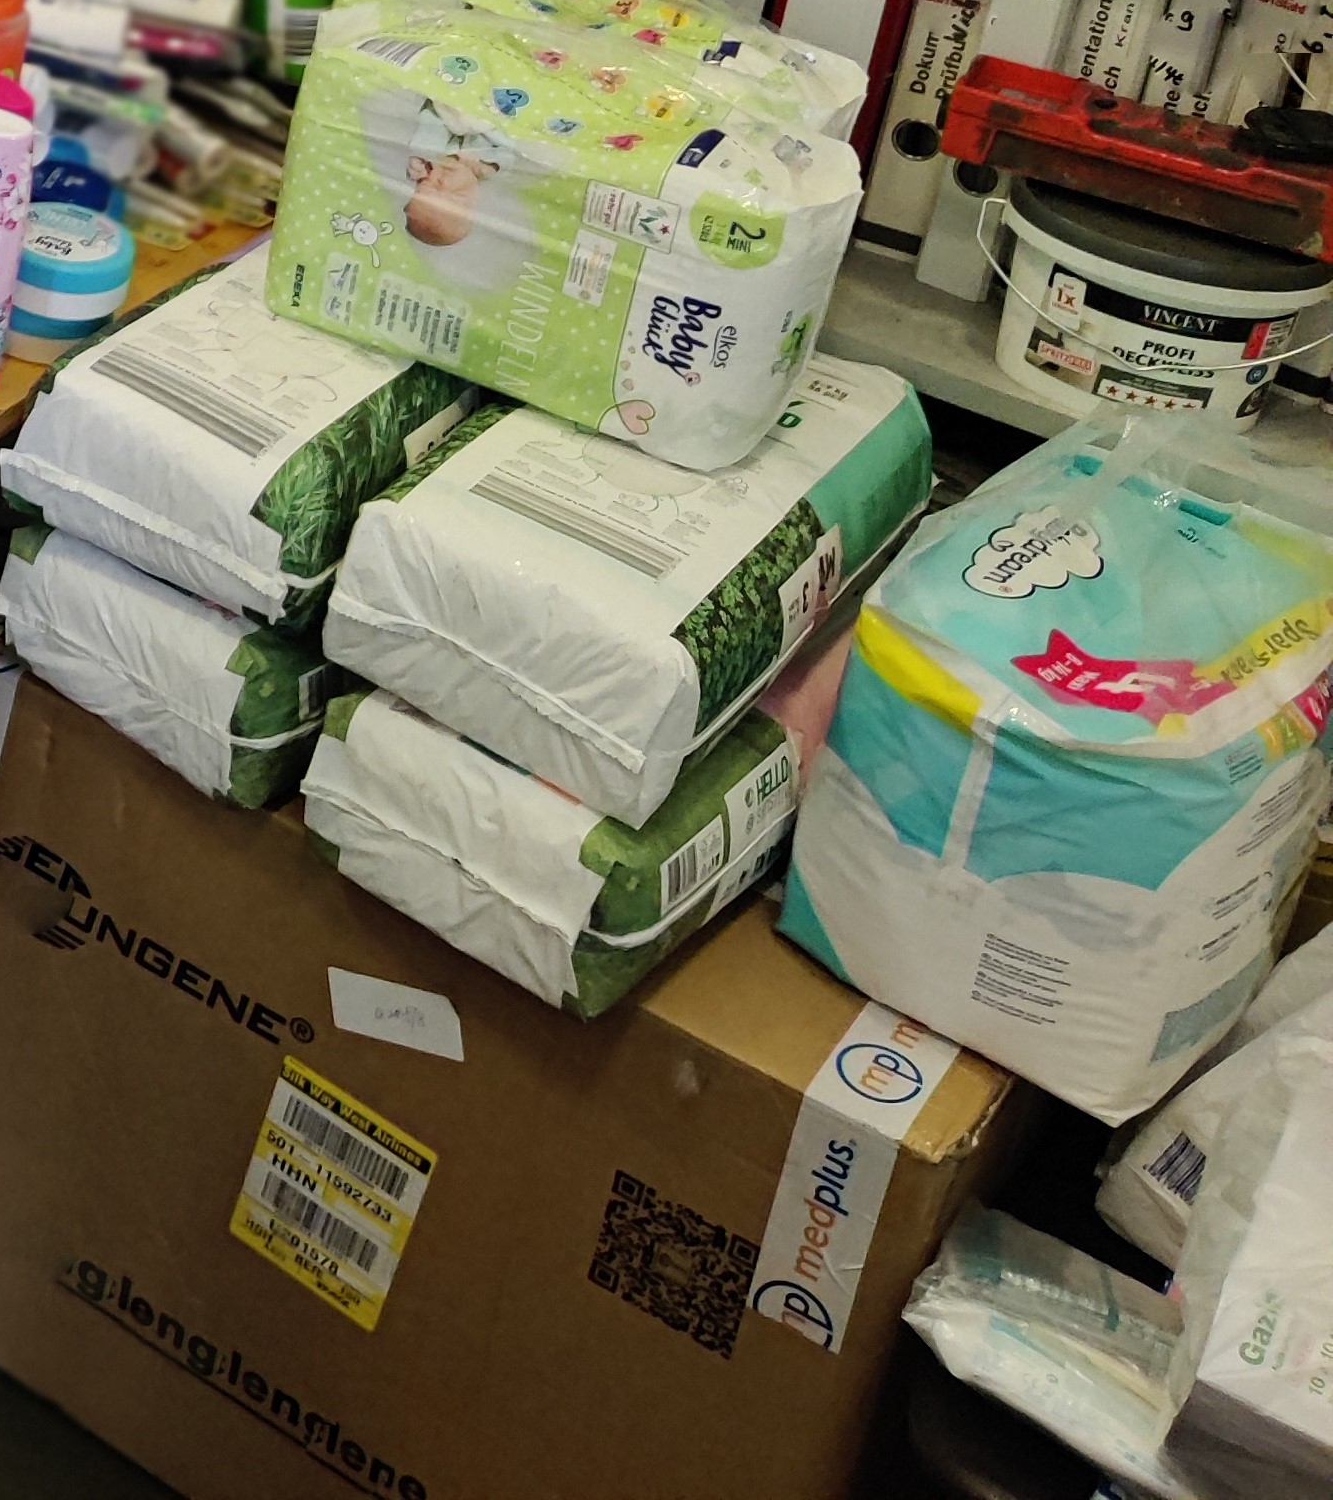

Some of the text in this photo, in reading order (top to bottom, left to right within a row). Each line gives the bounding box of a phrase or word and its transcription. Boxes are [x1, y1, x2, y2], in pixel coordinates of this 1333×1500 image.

[729, 220, 768, 241] 2
[289, 263, 306, 308] EDEKA
[493, 260, 561, 399] WINDELN
[641, 294, 681, 362] Glück
[669, 295, 723, 381] Baby
[1142, 304, 1219, 335] VINCENT
[713, 325, 738, 369] elkos
[1141, 339, 1196, 362] PROFI
[754, 756, 790, 805] HELLO
[270, 1152, 318, 1194] HHN
[792, 1136, 858, 1283] medplus
